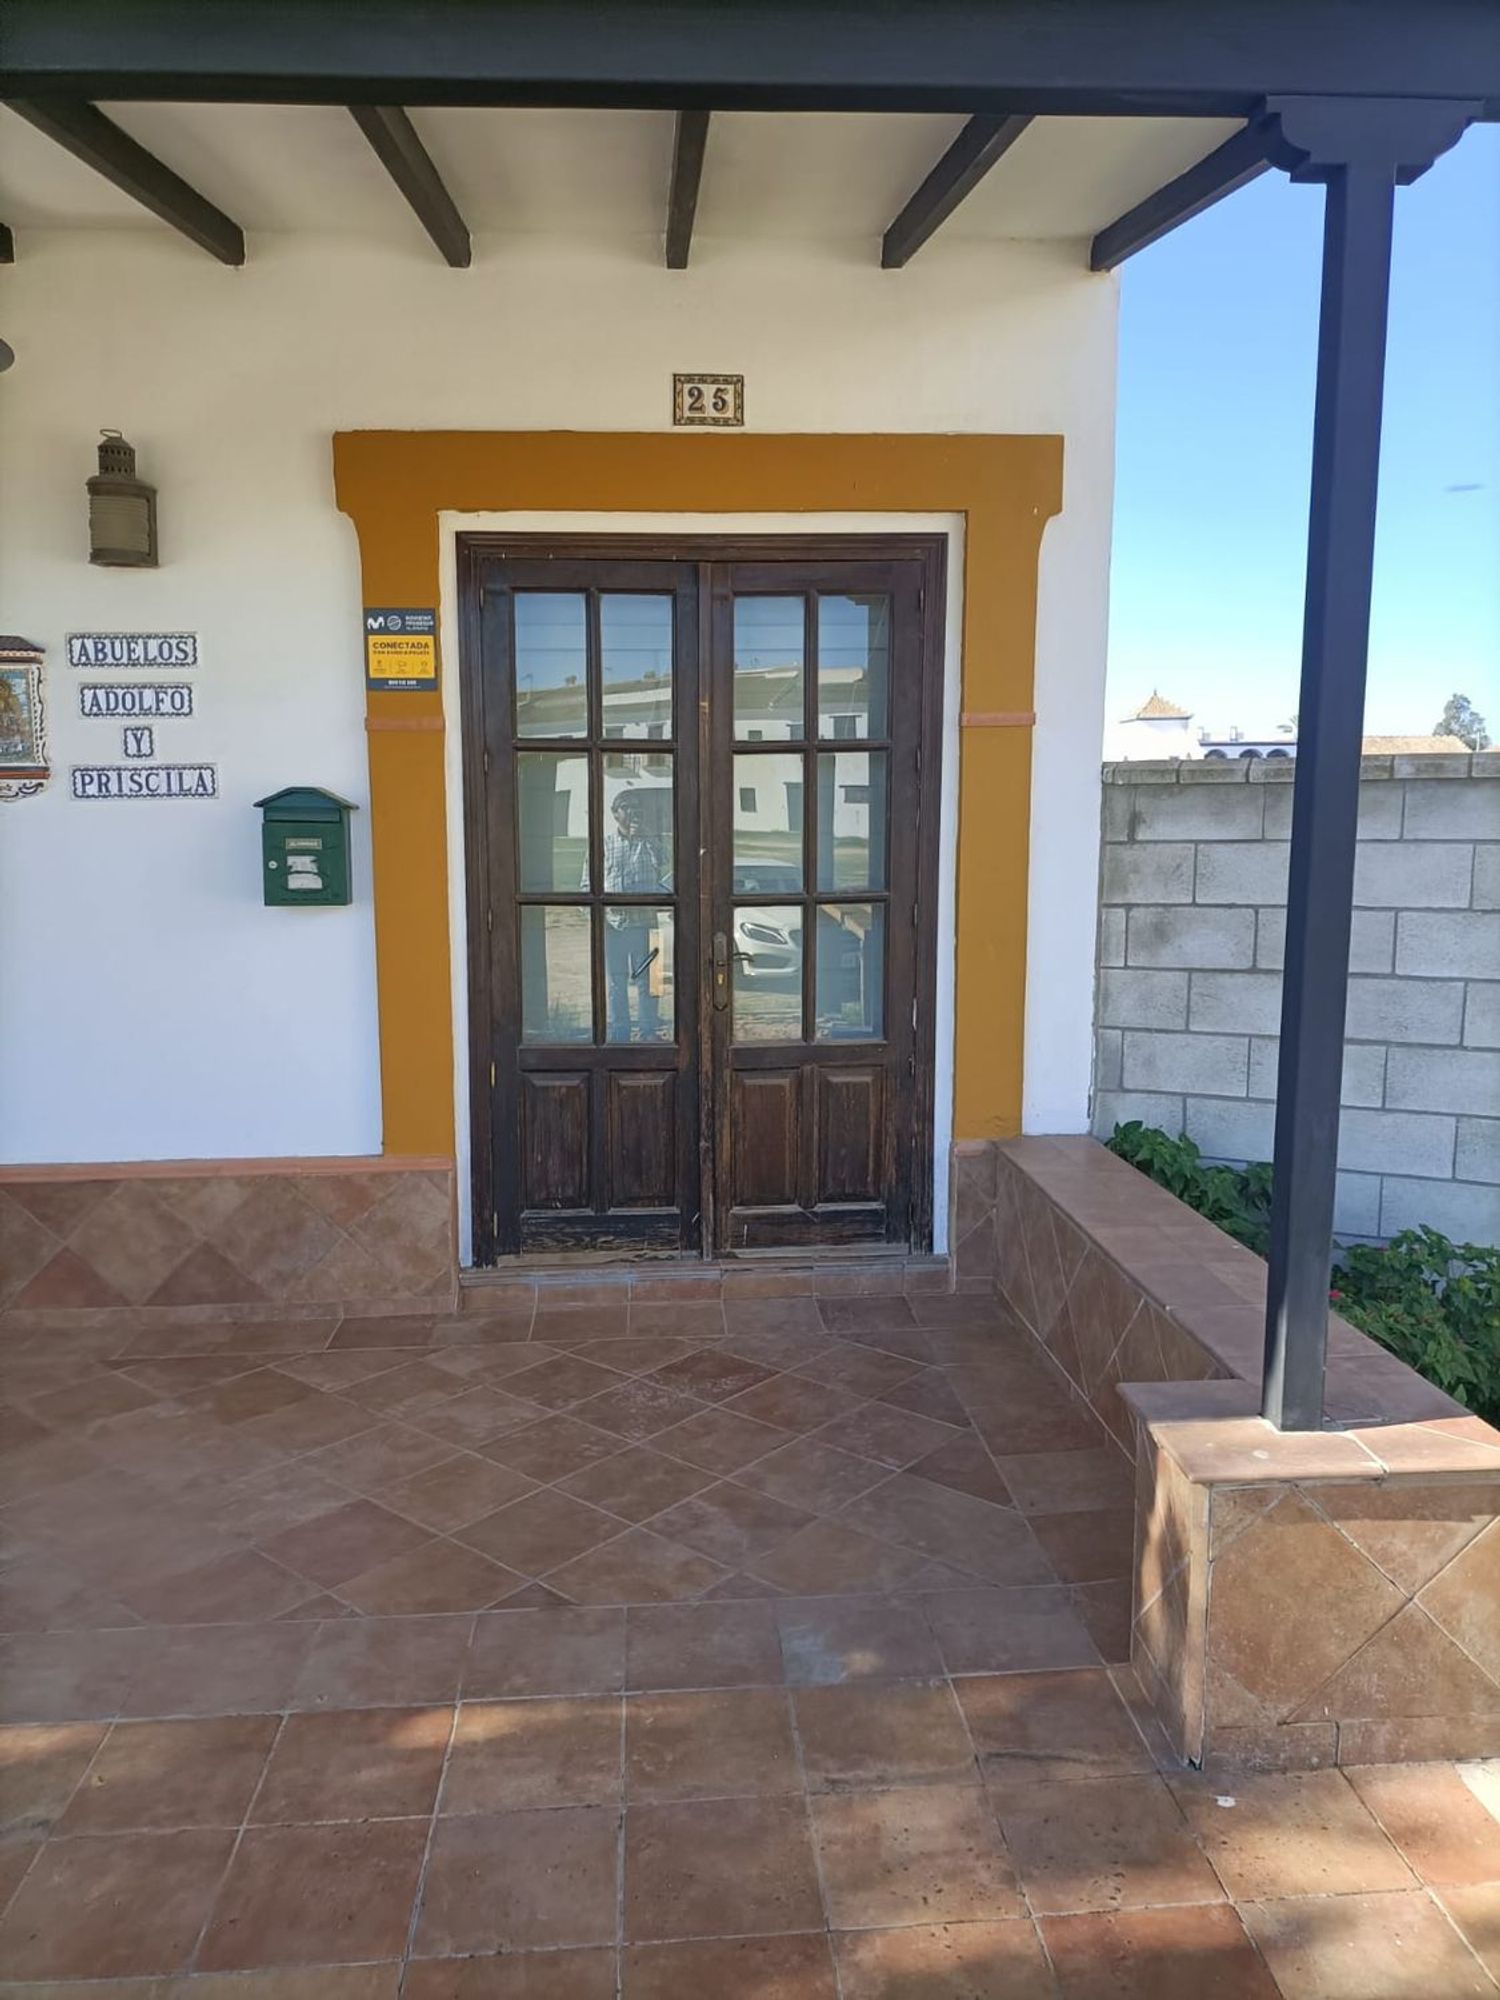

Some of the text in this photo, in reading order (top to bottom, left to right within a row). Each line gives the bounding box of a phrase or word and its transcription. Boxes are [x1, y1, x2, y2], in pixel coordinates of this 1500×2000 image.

[688, 386, 729, 415] 25
[77, 640, 189, 662] ABUELOS
[373, 641, 430, 649] CONECTADA
[89, 690, 185, 712] ADOLFO
[131, 732, 145, 753] Y
[80, 772, 209, 794] PRISCILA
